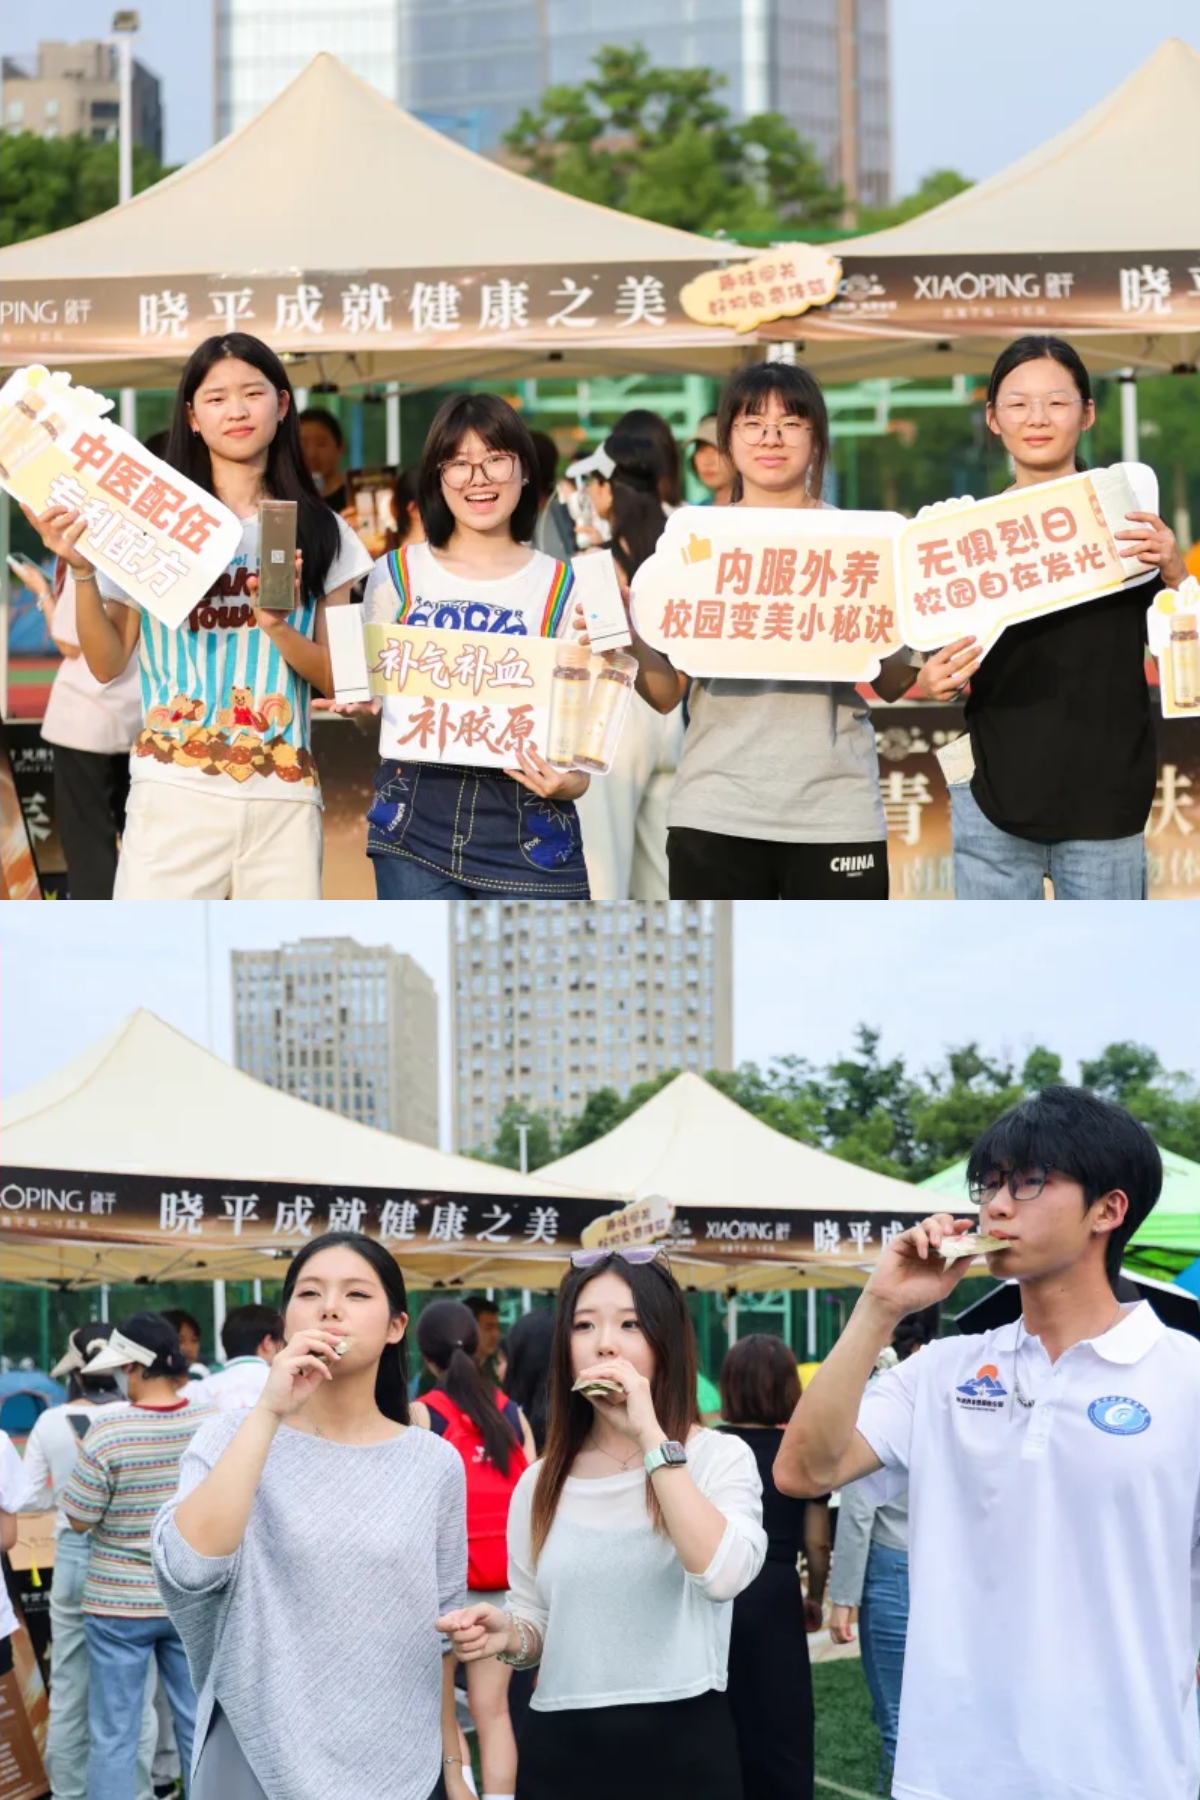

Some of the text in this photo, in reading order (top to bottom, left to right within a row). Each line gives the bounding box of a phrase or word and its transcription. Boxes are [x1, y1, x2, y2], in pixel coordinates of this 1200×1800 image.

[138, 274, 668, 338] 晓平成就健康之美
[913, 272, 1040, 299] XIAOPING
[1119, 265, 1200, 315] 晓
[70, 432, 223, 557] 中医配伍
[917, 505, 1078, 579] 无惧烈日
[714, 549, 881, 598] 内服外养
[913, 542, 1107, 616] 校园自在发光
[659, 598, 895, 645] 校园变美小秘诀
[374, 637, 535, 698] 补气补血
[397, 696, 540, 759] 补胶原
[830, 854, 875, 872] CHINA
[159, 1190, 561, 1246] 晓平成就健康之美
[706, 1220, 774, 1240] XIAOPING
